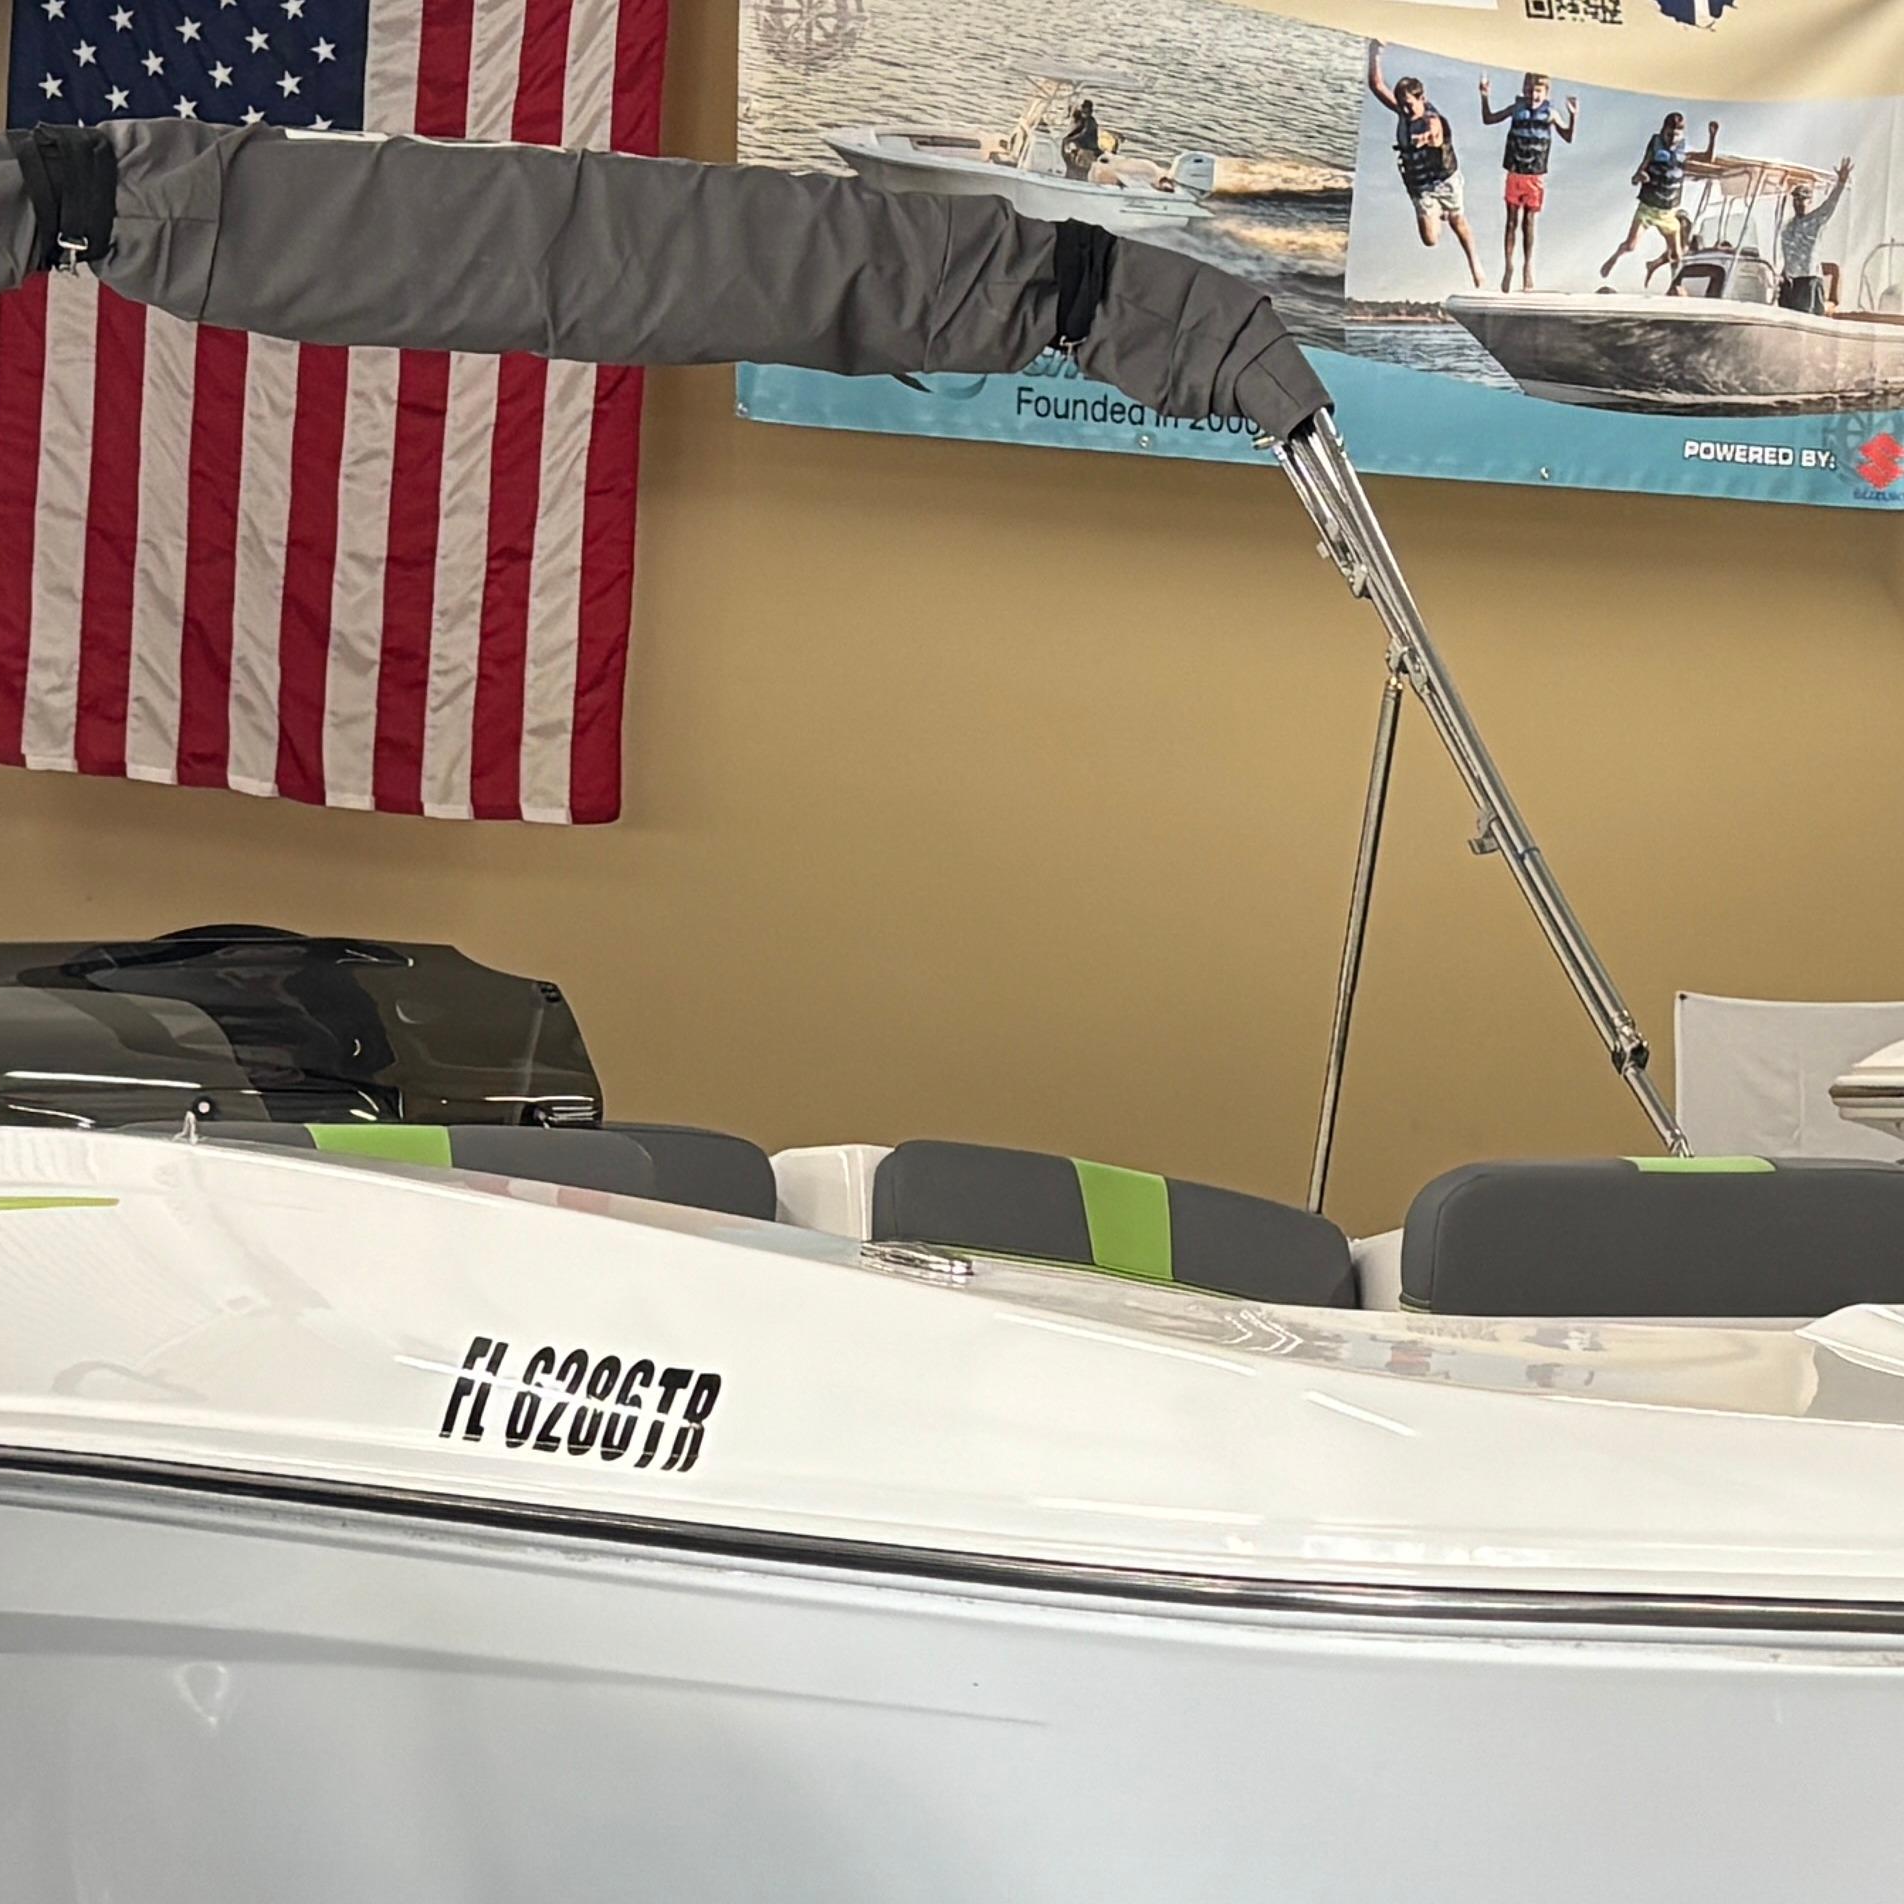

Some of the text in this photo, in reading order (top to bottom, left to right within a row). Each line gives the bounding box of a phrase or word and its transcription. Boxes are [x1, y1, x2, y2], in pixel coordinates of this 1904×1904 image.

[1016, 386, 1145, 426] Founded
[1683, 440, 1838, 470] POWERED BY:
[438, 1335, 509, 1442] FL
